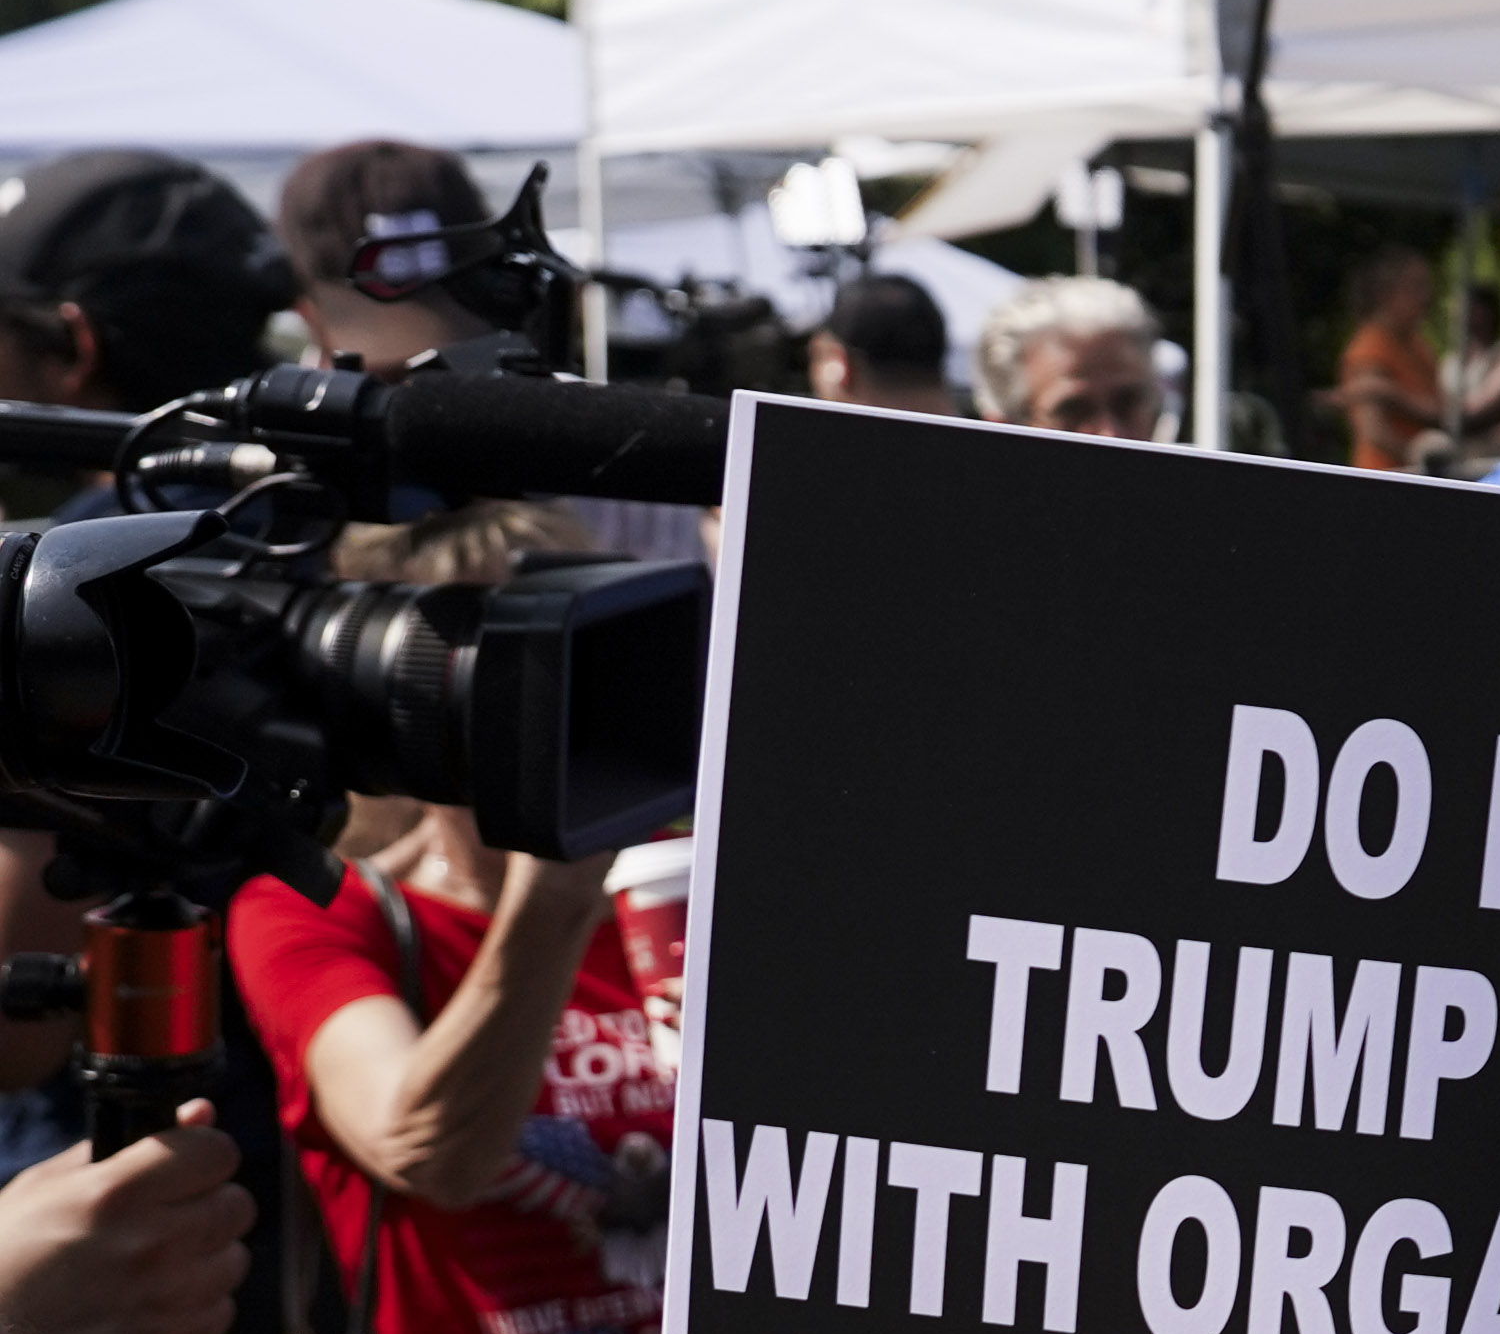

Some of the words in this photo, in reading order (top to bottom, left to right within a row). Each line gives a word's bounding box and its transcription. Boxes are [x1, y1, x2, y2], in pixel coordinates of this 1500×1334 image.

[1216, 705, 1431, 899] DO
[967, 915, 1497, 1140] TRUMP
[703, 1118, 1088, 1333] WITH
